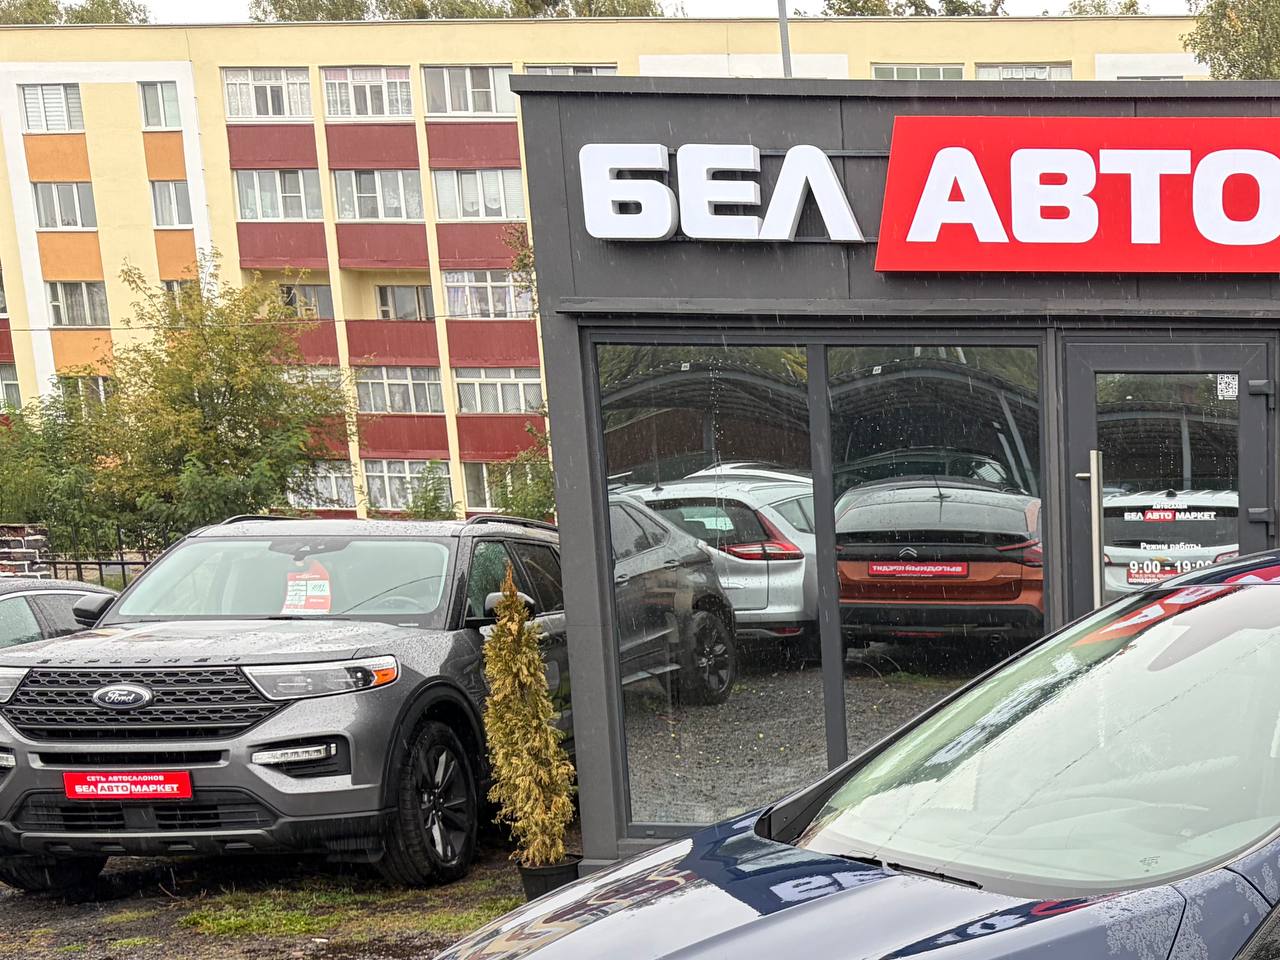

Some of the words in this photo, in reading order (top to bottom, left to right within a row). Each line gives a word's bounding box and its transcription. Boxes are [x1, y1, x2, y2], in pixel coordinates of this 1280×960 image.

[579, 142, 866, 242] БЕЛ
[1124, 511, 1144, 520] БЕЛ
[1145, 511, 1173, 520] АВТО
[1175, 511, 1217, 520] МАРКЕТ
[1140, 542, 1168, 551] Режим
[1169, 542, 1202, 552] работы
[1129, 560, 1161, 573] 9:00
[105, 690, 136, 703] Ford
[75, 784, 97, 793] БЕЛ
[99, 784, 129, 793] АВТО
[131, 784, 179, 793] МАРКЕТ
